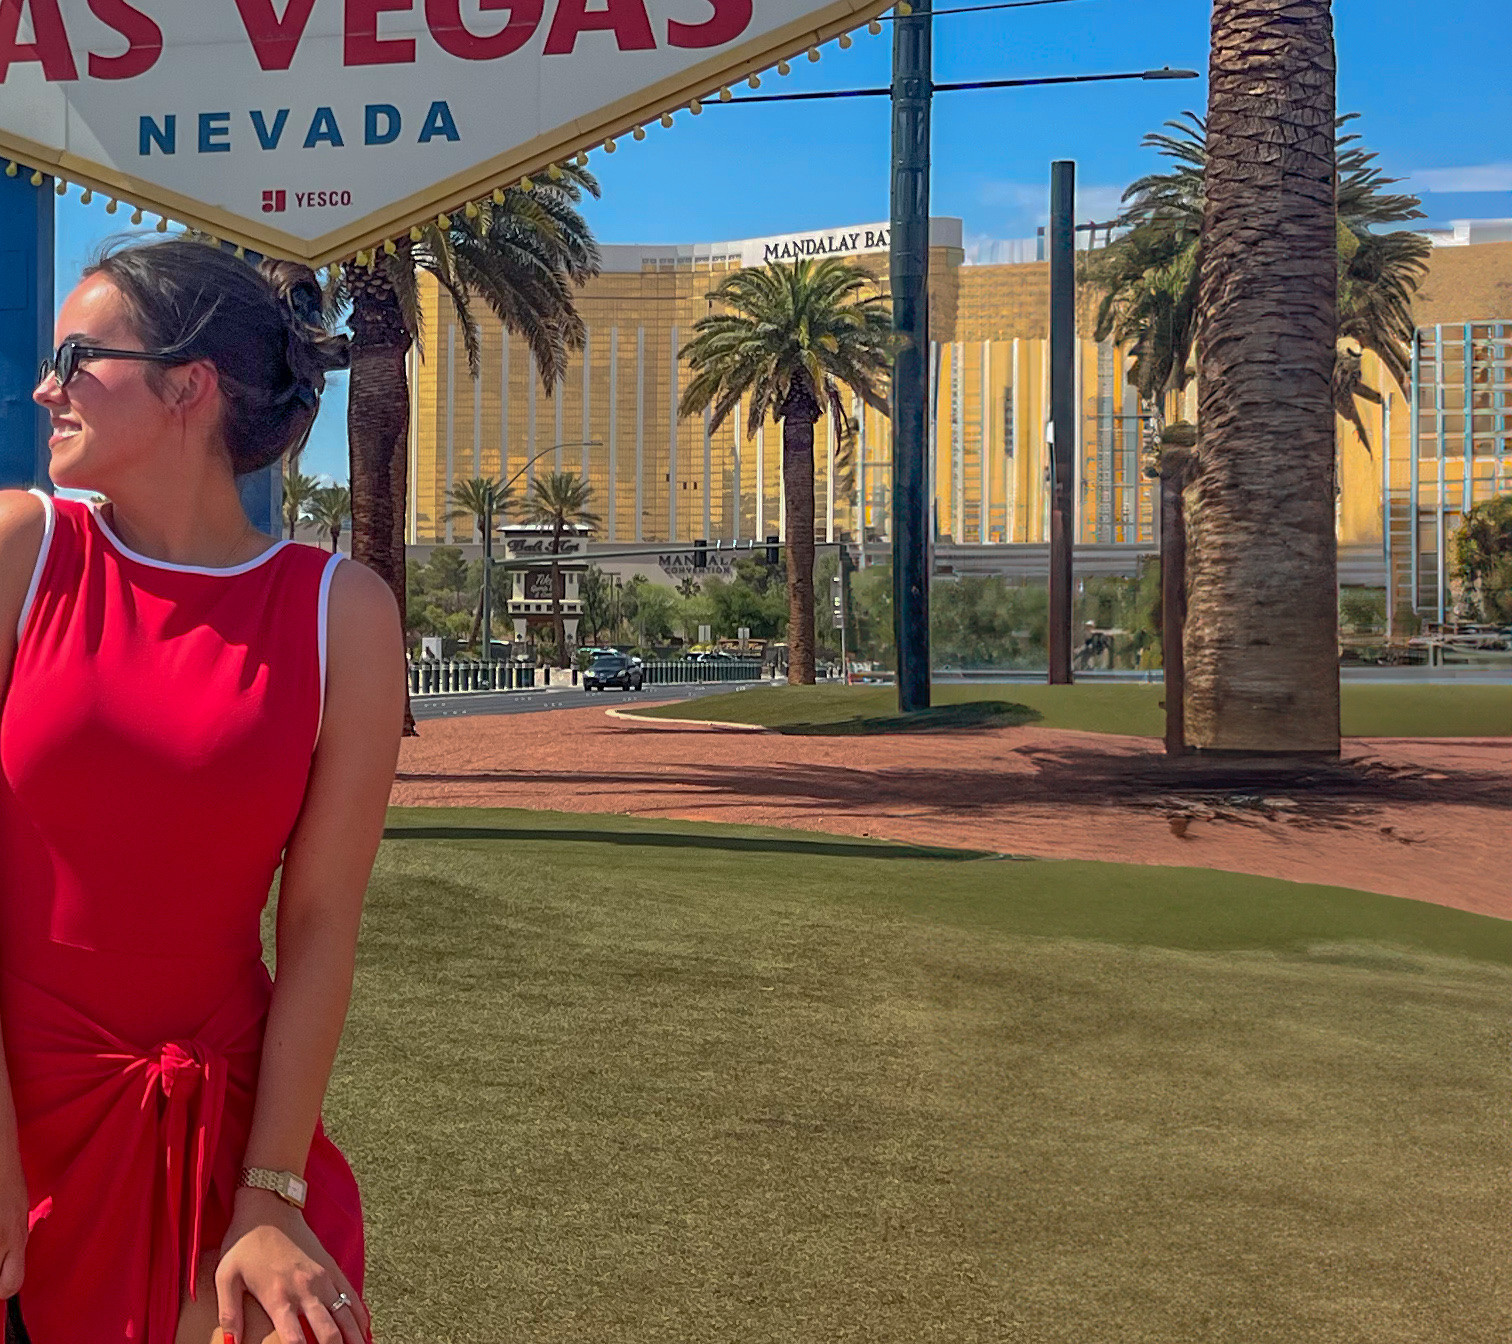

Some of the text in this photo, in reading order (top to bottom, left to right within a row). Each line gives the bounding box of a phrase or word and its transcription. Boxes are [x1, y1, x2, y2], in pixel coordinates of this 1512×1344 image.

[138, 101, 462, 156] NEVADA
[295, 190, 351, 208] YESCO
[763, 233, 861, 260] MANDALAY
